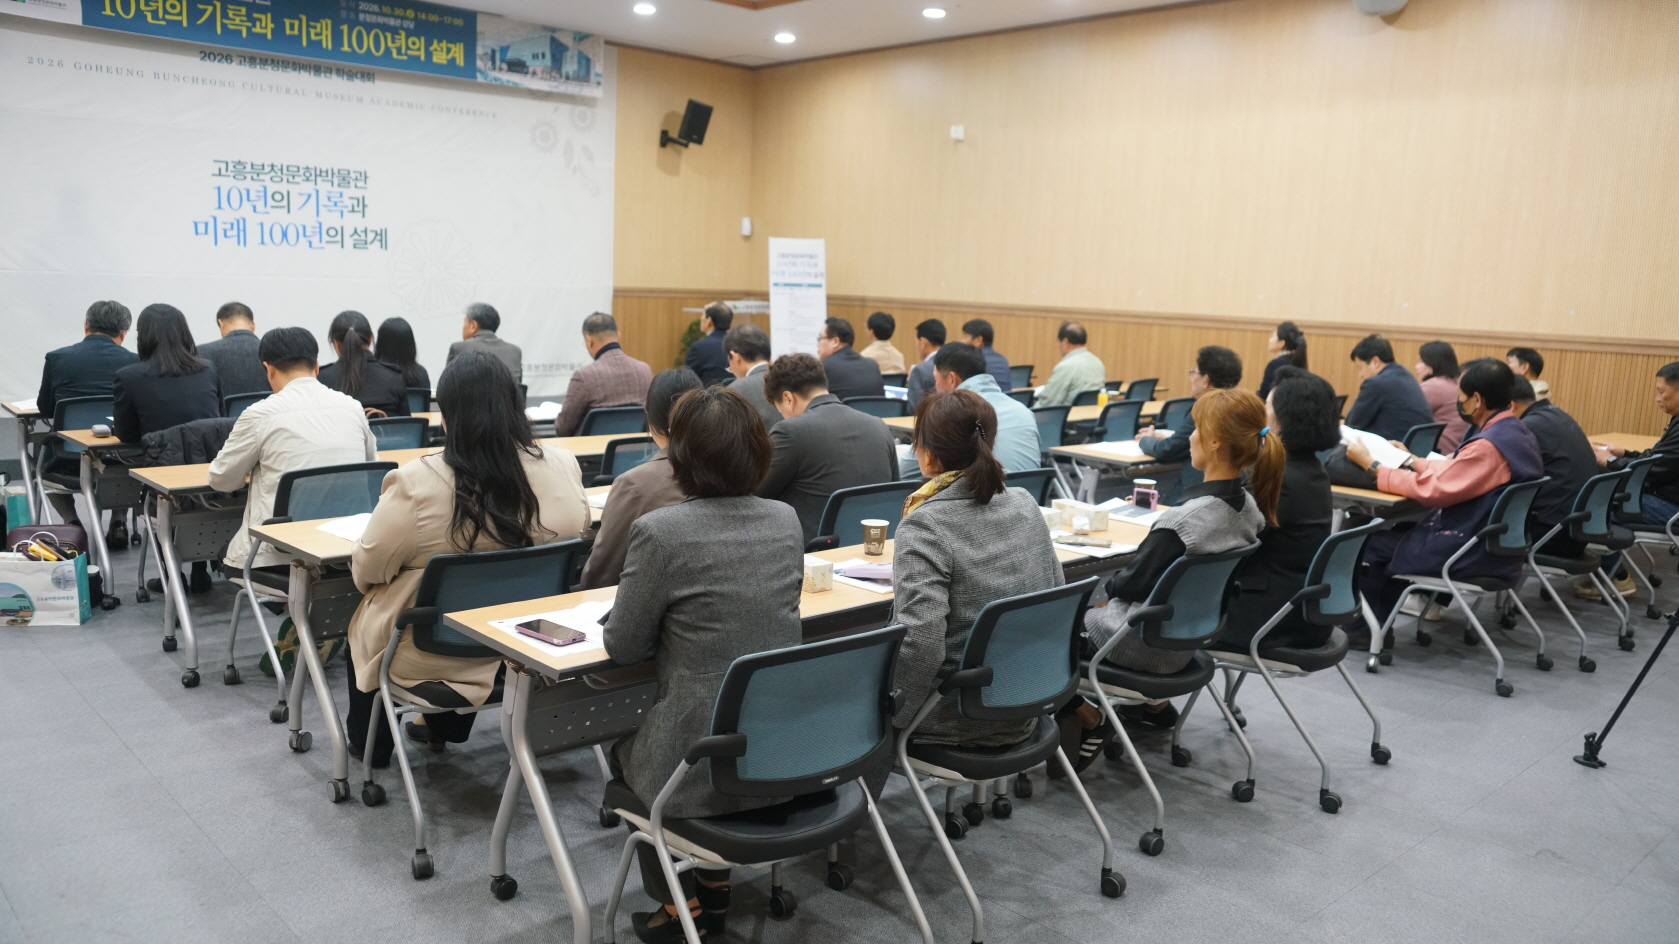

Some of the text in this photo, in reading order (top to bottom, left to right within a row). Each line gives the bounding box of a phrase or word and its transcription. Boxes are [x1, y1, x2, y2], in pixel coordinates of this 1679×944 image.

[196, 1, 275, 40] 기록과
[284, 14, 332, 50] 미래
[339, 25, 425, 61] 100년의
[429, 39, 465, 66] 설계
[199, 50, 375, 84] 2026 고흥분청문화박물관 학술대회
[27, 56, 498, 118] 2026 GOHEUNG BUNCHEONG CULTURAL MUSEUM ACADEMIC CONFERENCE
[211, 159, 369, 189] 고흥분청문화박물관
[213, 185, 368, 219] 10년의 기록과
[192, 215, 388, 250] 미래 100년의 설계
